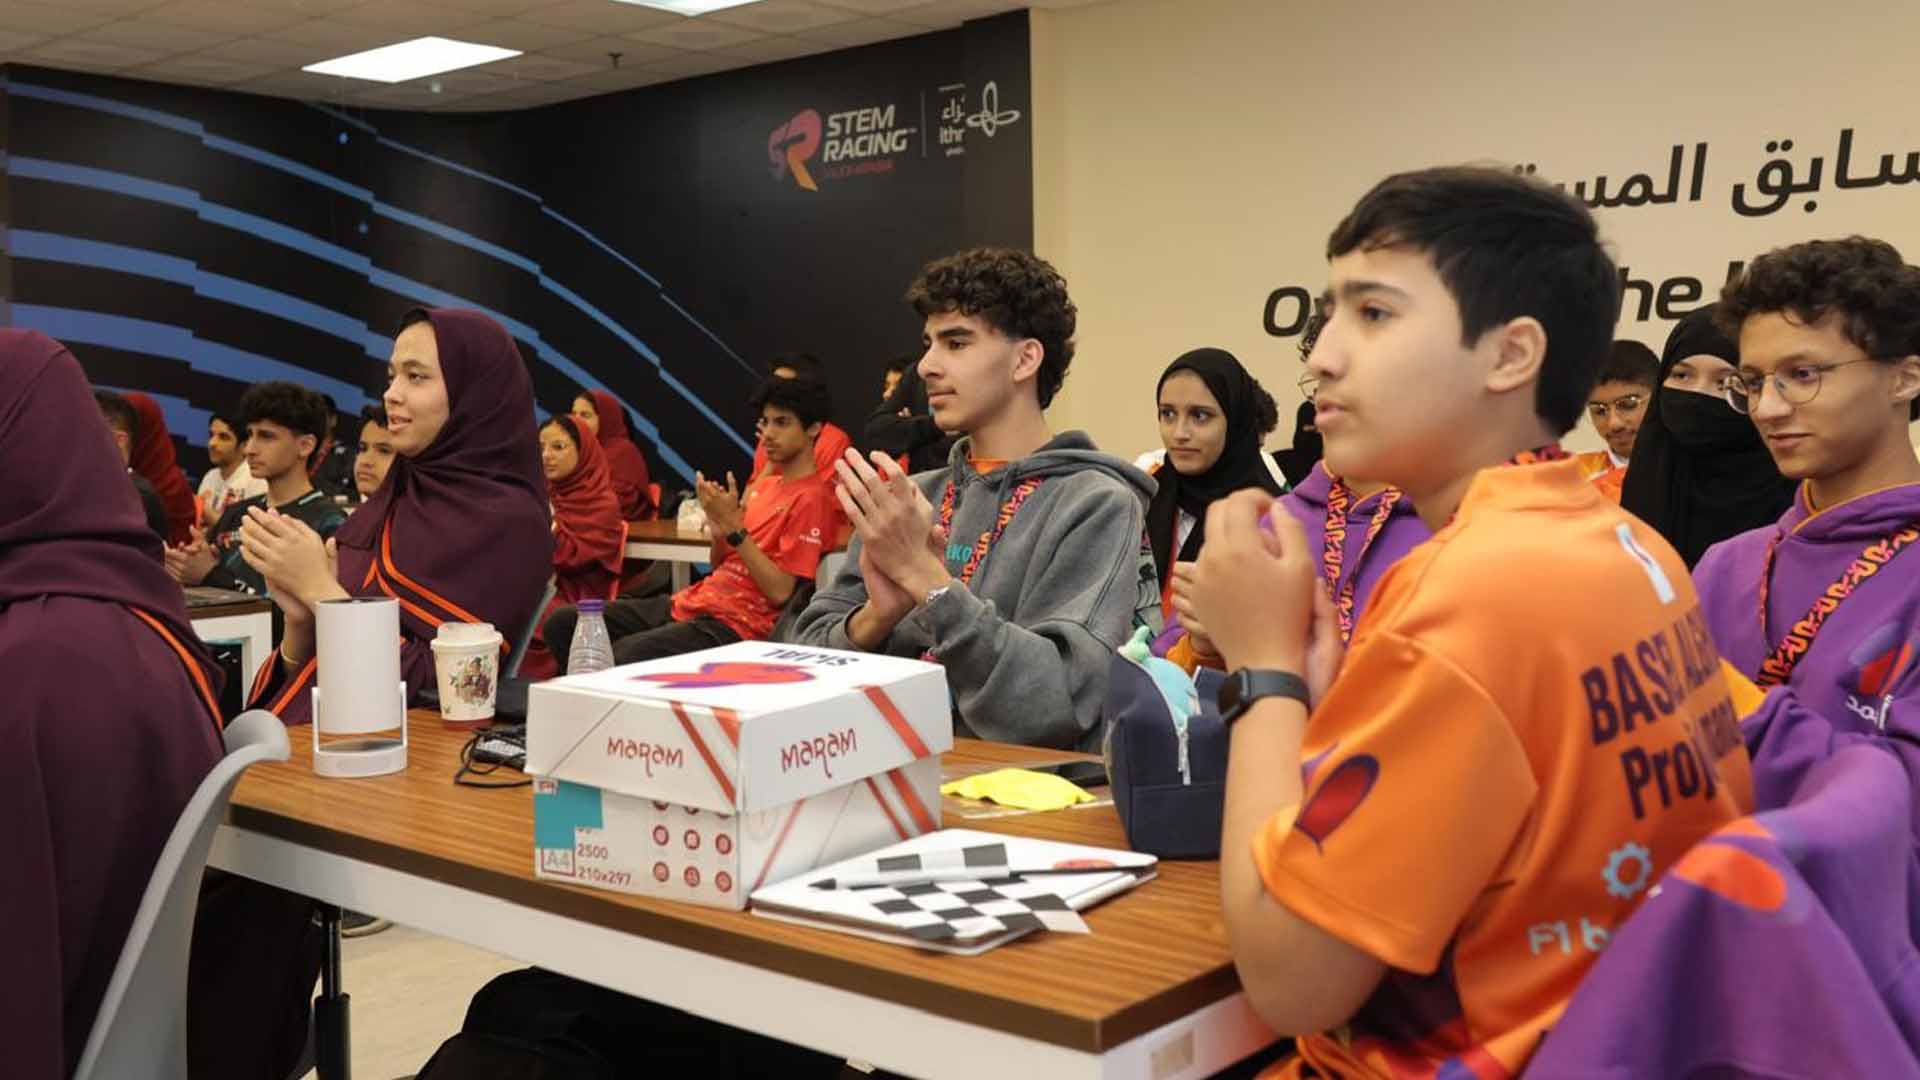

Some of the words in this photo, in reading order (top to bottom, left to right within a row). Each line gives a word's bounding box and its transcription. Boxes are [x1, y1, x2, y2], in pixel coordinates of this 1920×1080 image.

[826, 104, 896, 138] STEM
[823, 129, 909, 163] RACING
[1614, 266, 1703, 321] he
[577, 843, 609, 860] 2500
